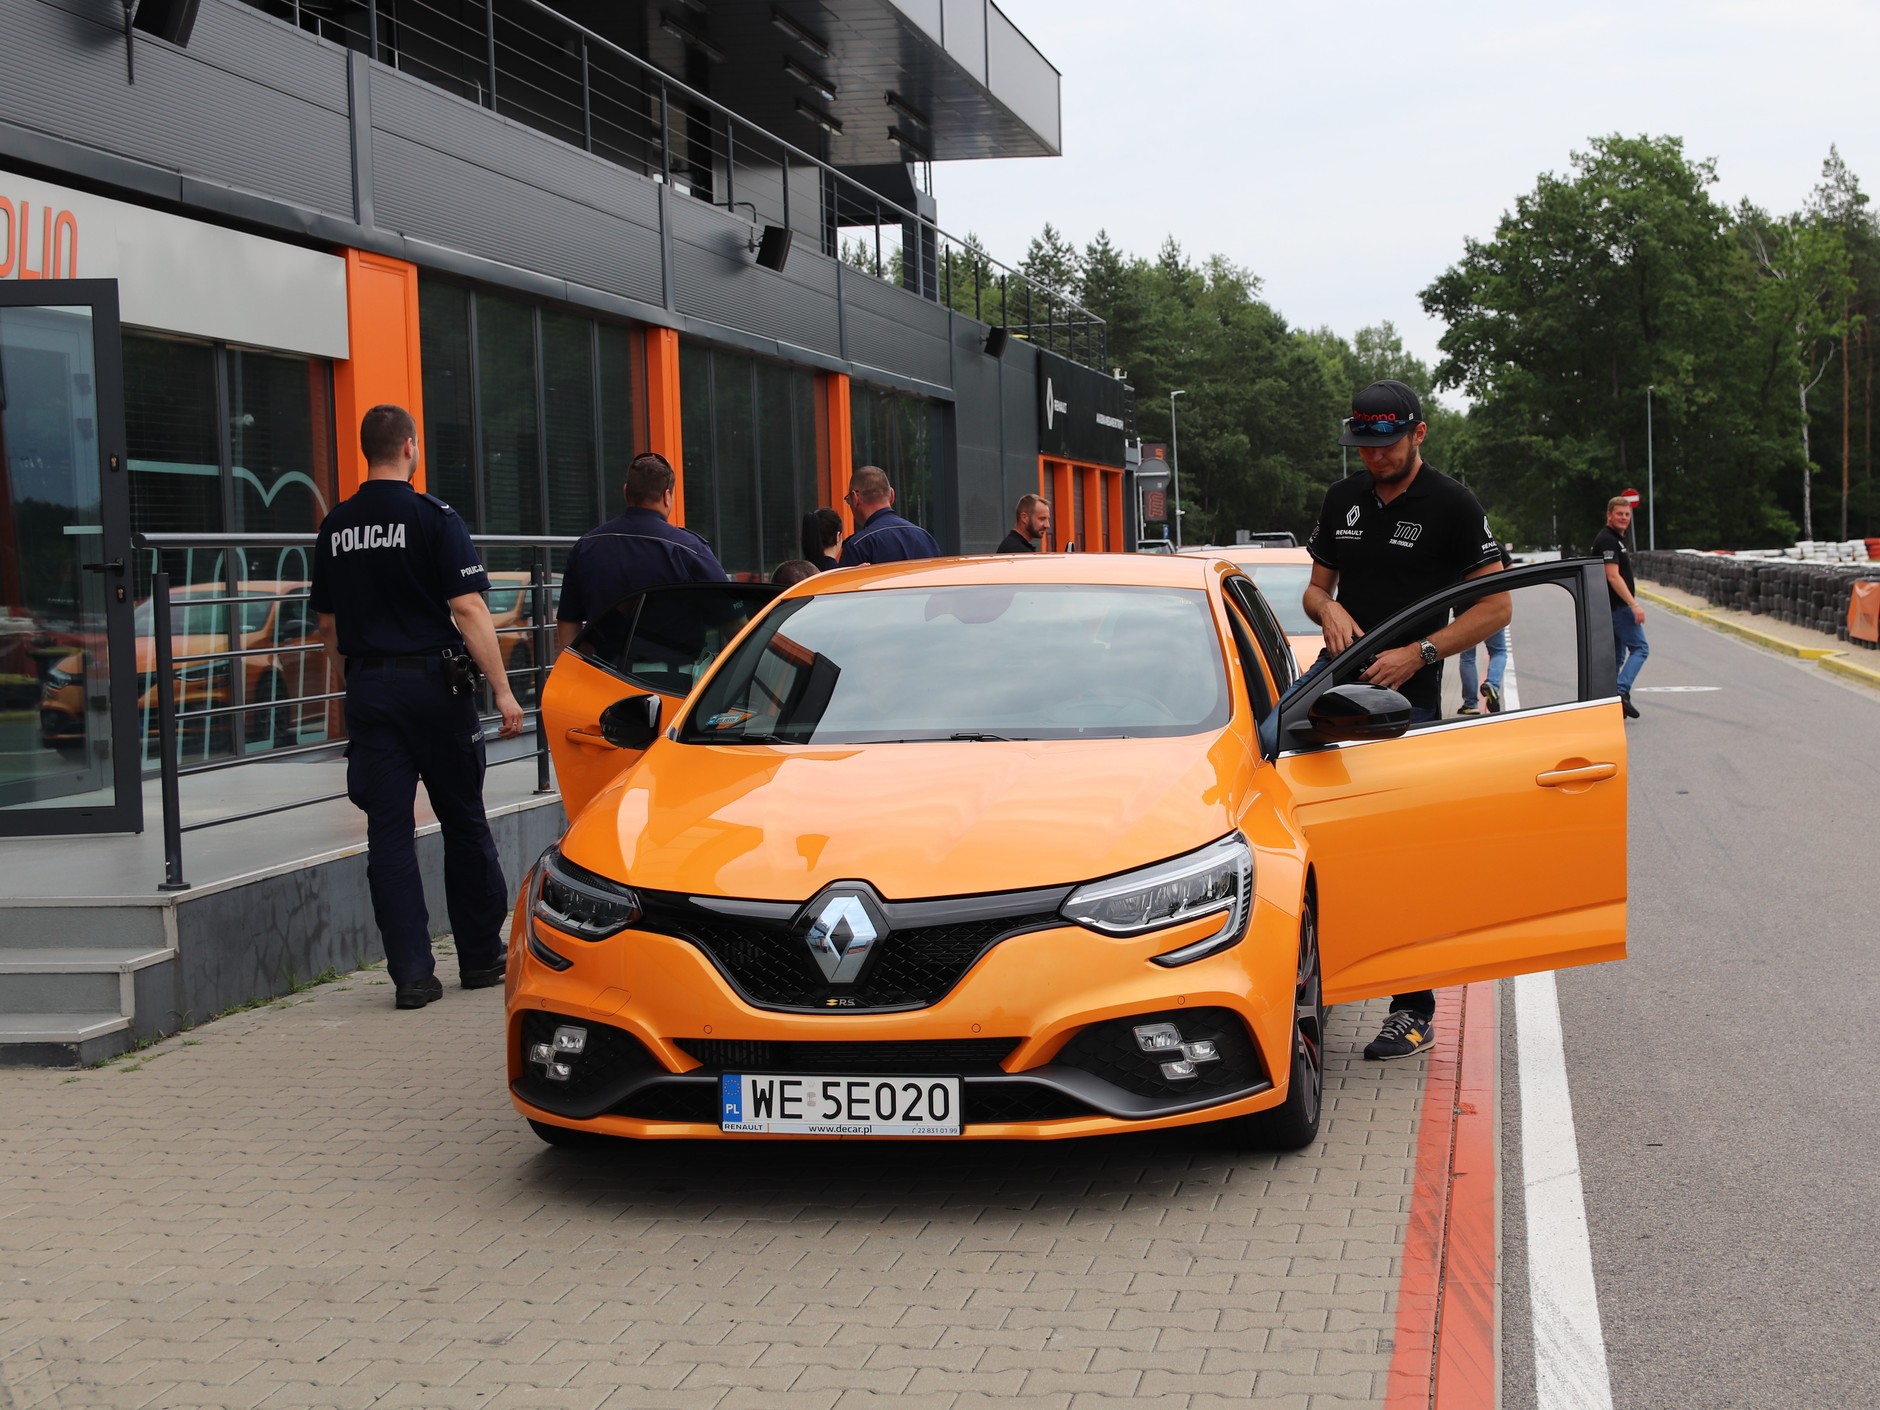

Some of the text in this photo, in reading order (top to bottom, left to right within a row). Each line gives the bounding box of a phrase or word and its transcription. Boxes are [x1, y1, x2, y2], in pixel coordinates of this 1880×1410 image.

[331, 523, 406, 557] POLICJA
[460, 564, 485, 578] POLICJA
[751, 1079, 950, 1122] WE 5E020
[725, 1103, 740, 1115] PL
[724, 1123, 764, 1132] RENAULT
[808, 1124, 873, 1136] www.decar.pl
